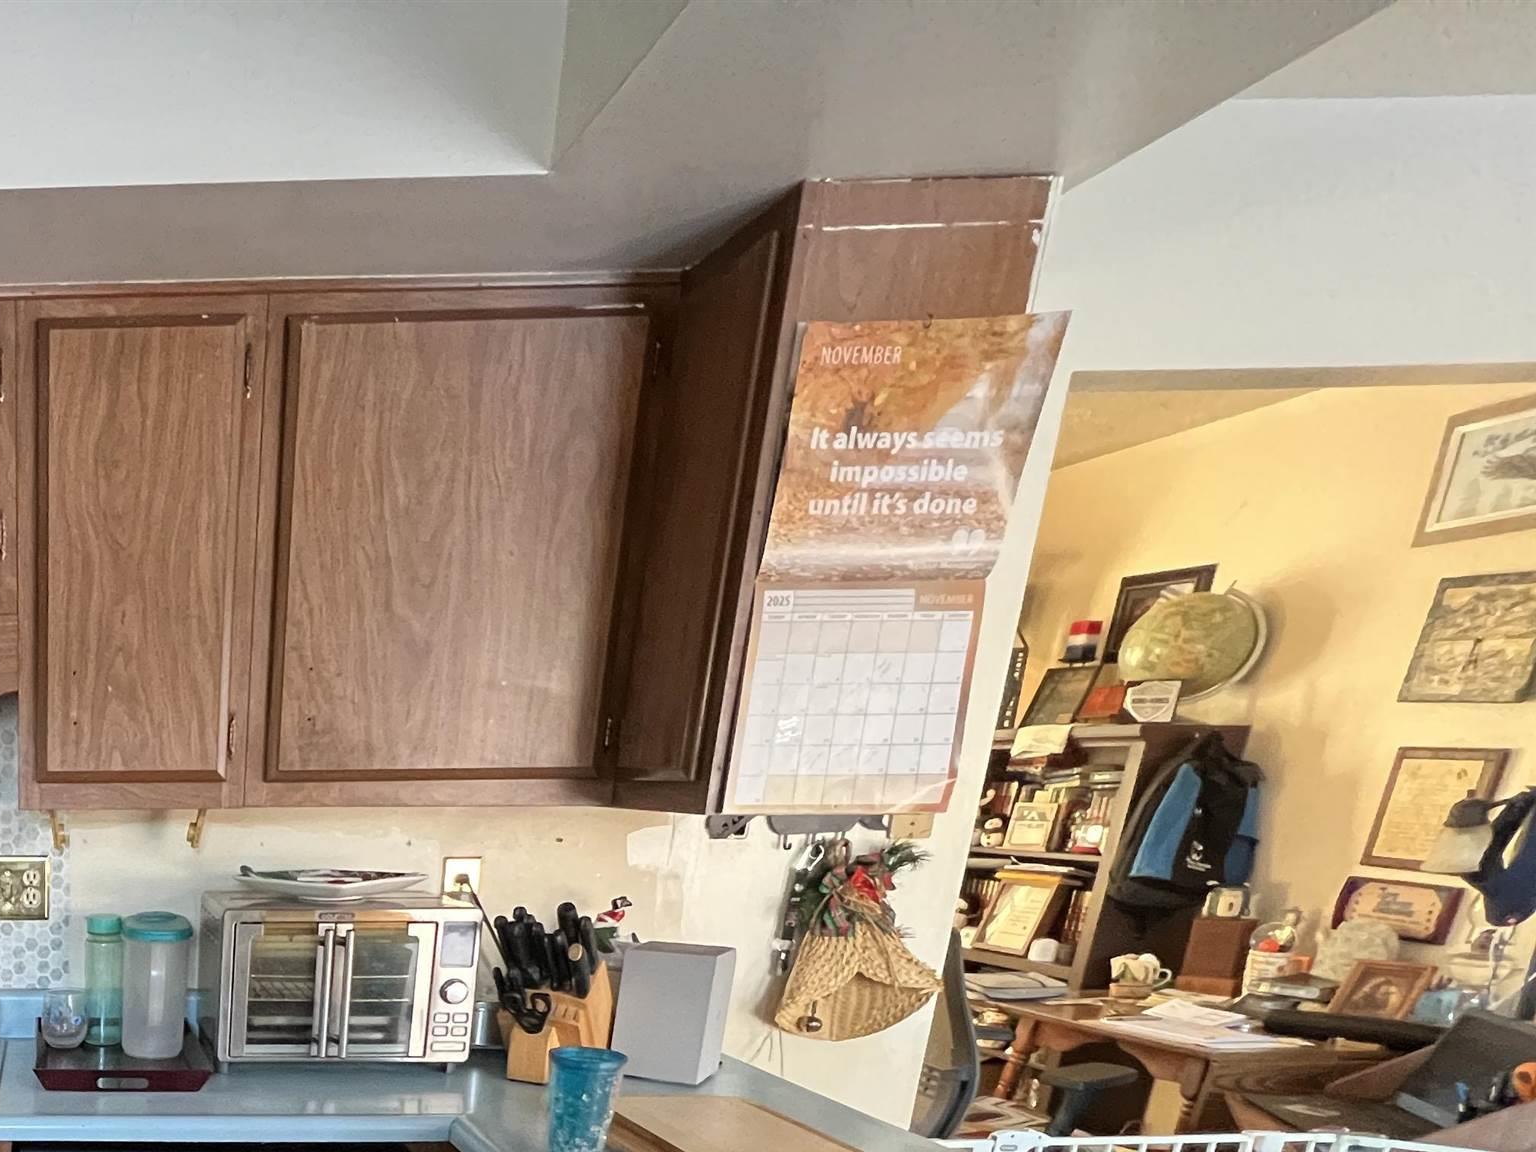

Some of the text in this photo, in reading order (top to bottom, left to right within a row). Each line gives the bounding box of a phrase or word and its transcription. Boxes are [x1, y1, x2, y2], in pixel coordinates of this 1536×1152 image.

[820, 345, 903, 365] NOVEMBER
[810, 426, 1004, 454] It always seems
[830, 458, 968, 488] impossible
[809, 492, 977, 515] until it's done
[767, 595, 791, 607] 2025
[919, 594, 974, 605] NOVEMBER
